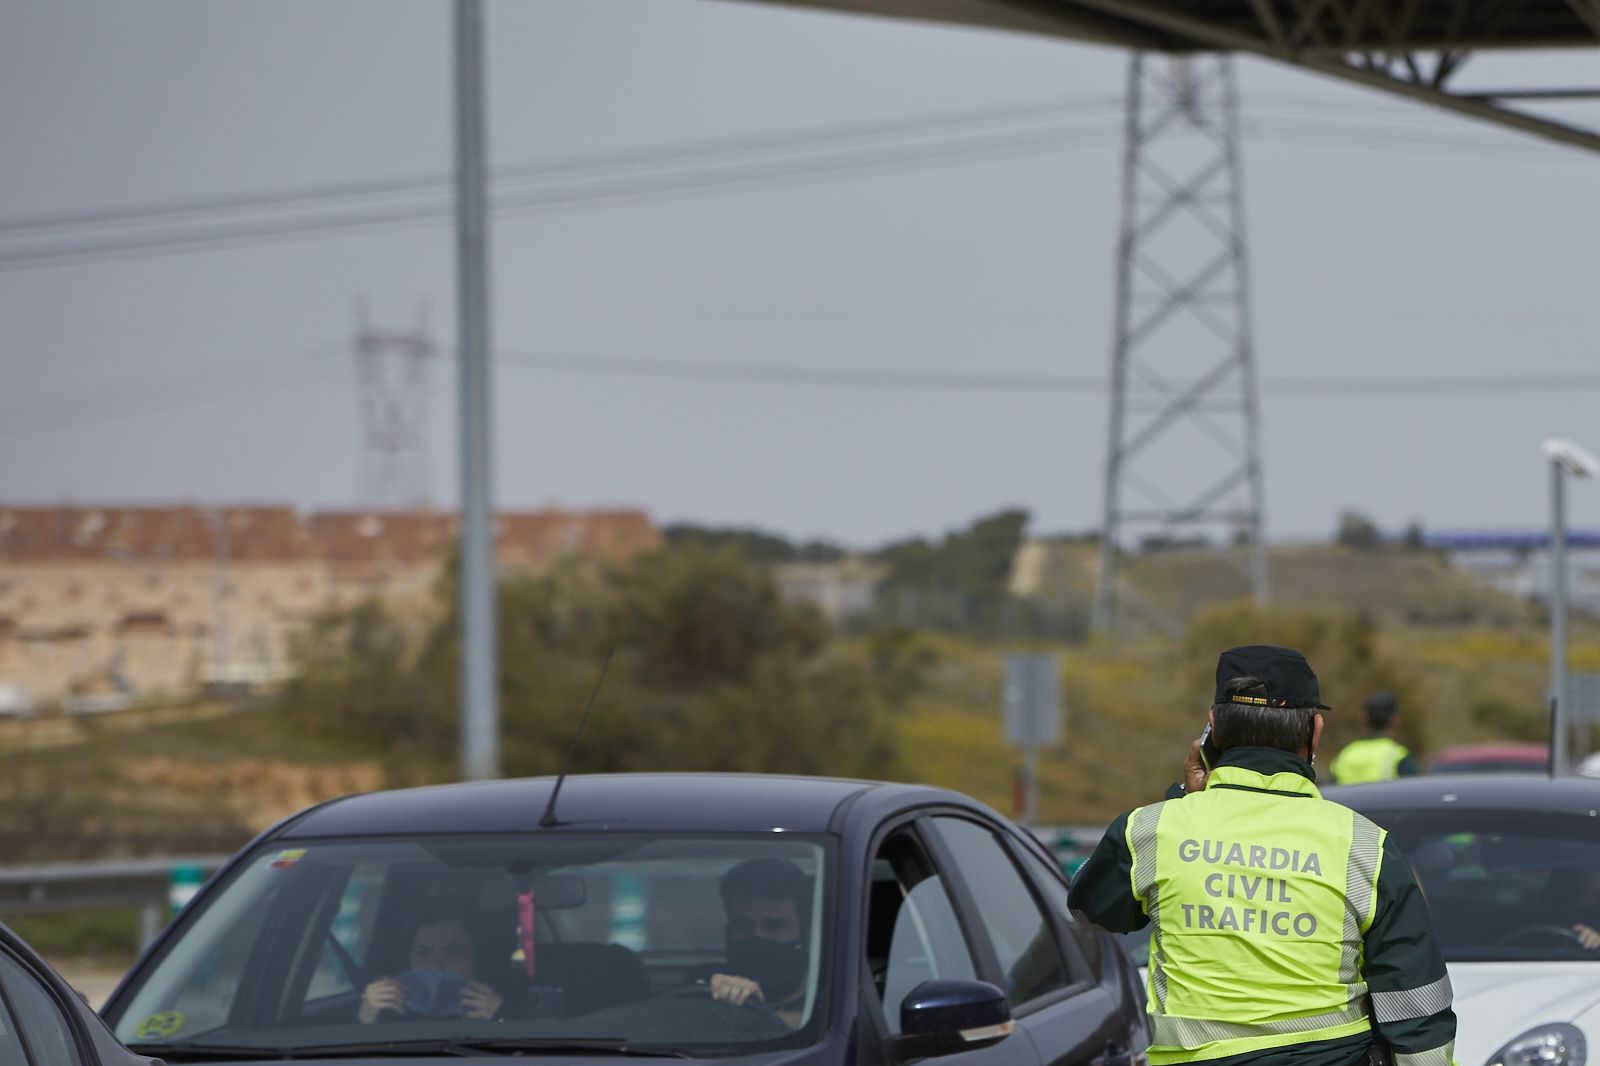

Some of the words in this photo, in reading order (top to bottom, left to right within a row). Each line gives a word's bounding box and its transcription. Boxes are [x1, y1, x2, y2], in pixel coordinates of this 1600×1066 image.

[1178, 839, 1322, 876] GUARDIA
[1204, 873, 1291, 903] CIVIL
[1181, 904, 1317, 937] TRAFICO
